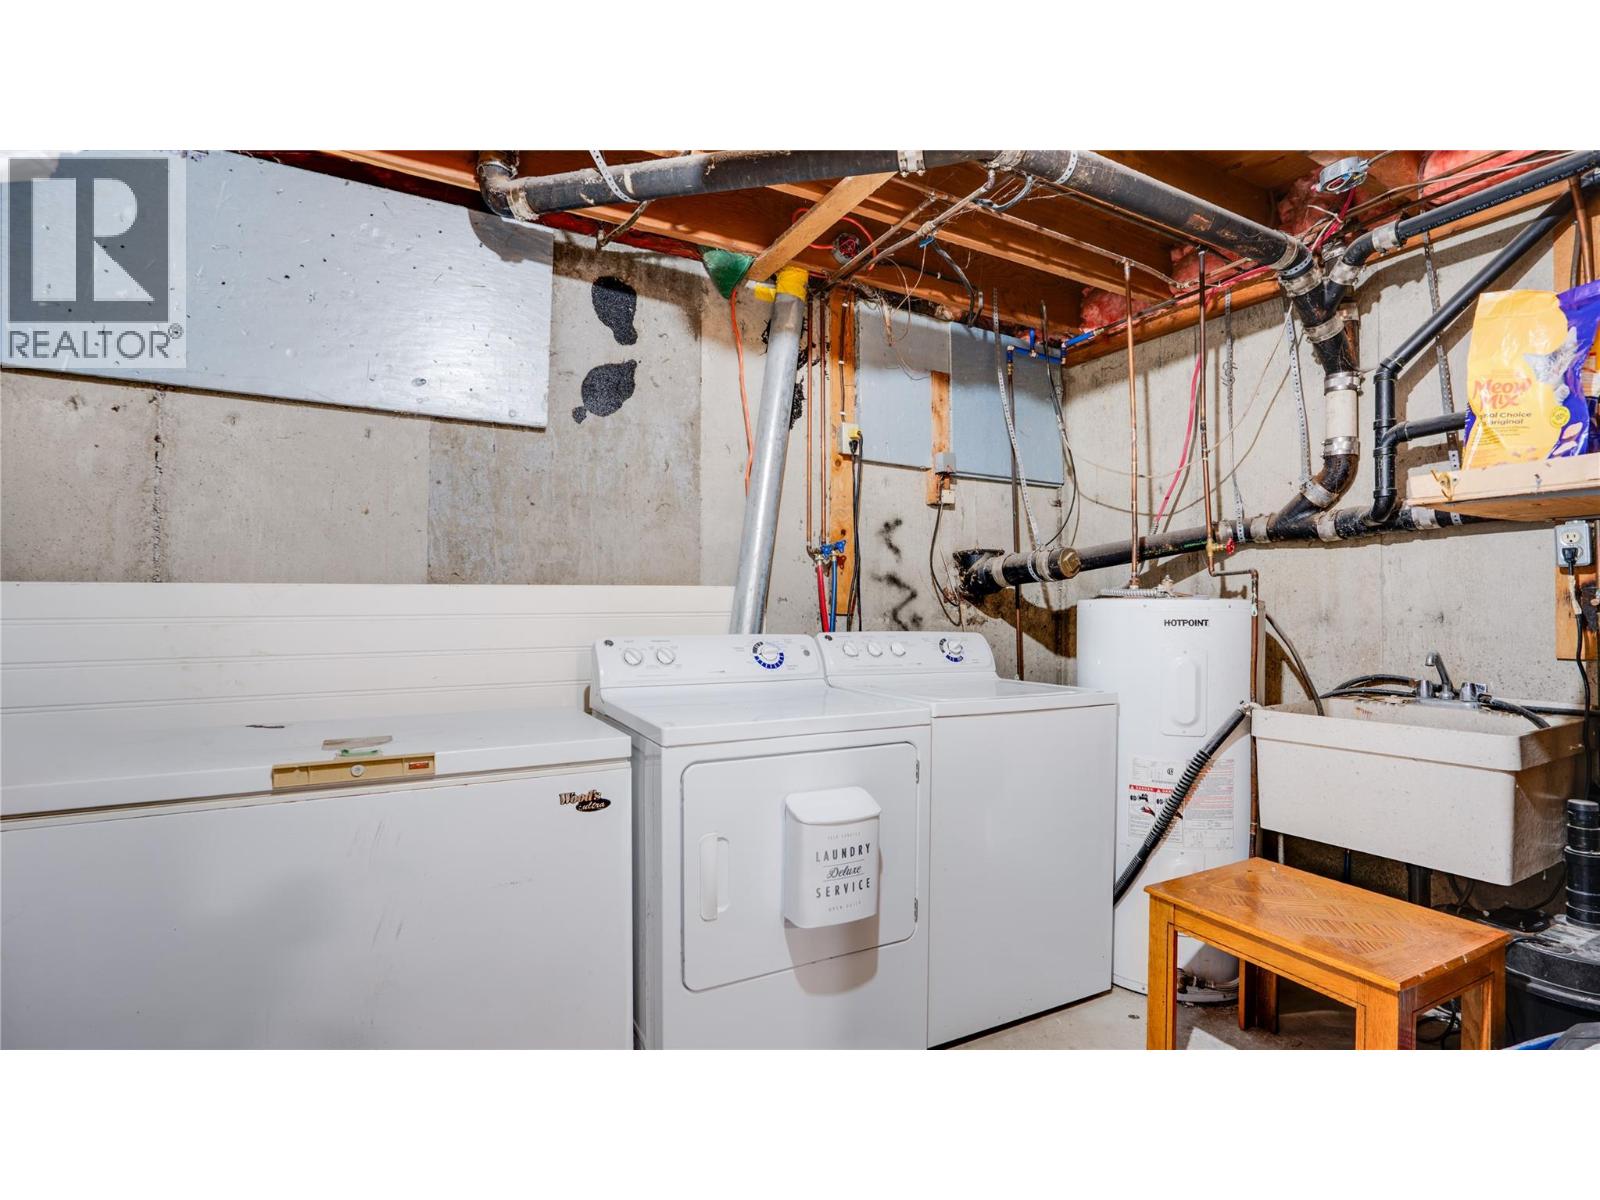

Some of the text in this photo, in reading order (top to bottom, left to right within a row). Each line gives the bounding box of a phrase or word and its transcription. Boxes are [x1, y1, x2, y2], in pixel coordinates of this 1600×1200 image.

[1473, 377, 1533, 400] Meow
[1499, 411, 1532, 419] Choice
[1163, 618, 1209, 627] HOTPOINT
[815, 842, 871, 863] LAUNDRY
[826, 865, 862, 880] Deluxe
[815, 877, 871, 899] SERVICE
